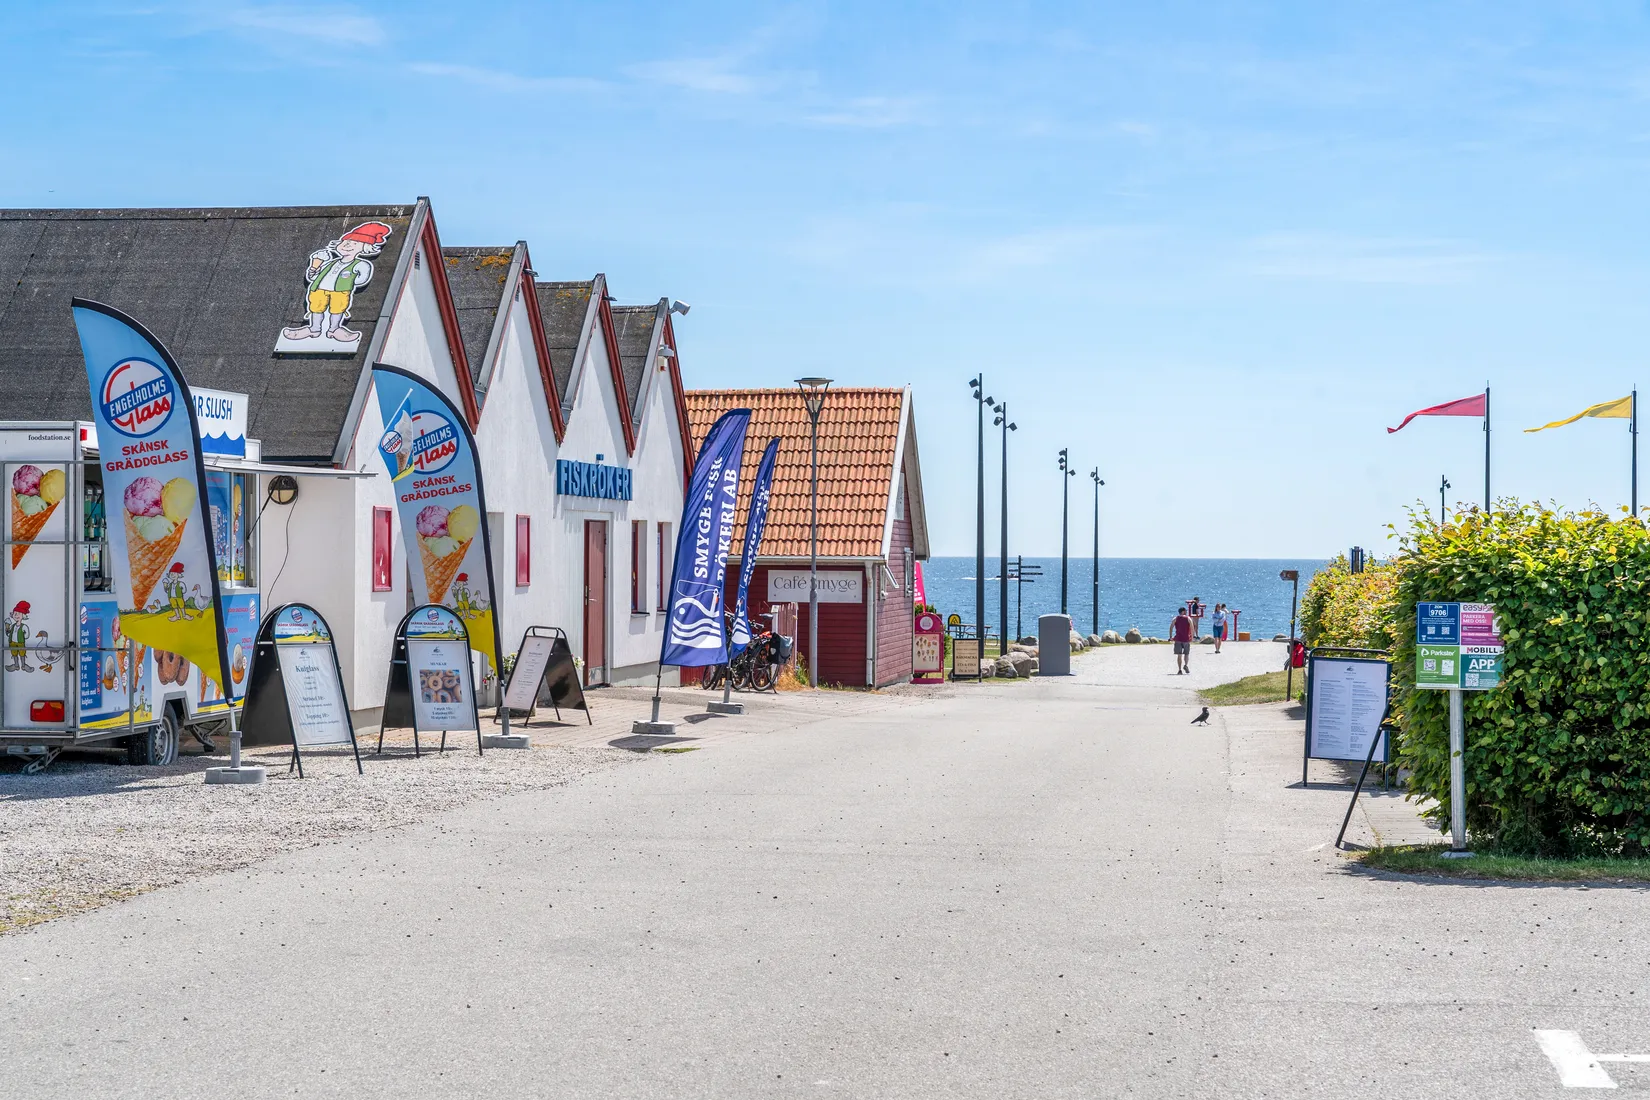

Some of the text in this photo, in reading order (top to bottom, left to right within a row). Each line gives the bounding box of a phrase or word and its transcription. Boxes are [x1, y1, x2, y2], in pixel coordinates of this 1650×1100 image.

[109, 379, 167, 418] ENGELHOLMS
[205, 397, 232, 420] SLUSH
[121, 440, 169, 456] SKÅNSK
[413, 427, 452, 453] GELHOLMS
[106, 450, 189, 472] GRÄDDGLASS
[412, 475, 456, 489] SKÅNSK
[557, 454, 633, 501] FISKRÖKERI
[723, 469, 737, 499] AB
[401, 483, 472, 503] GRÄDDGLASS
[694, 507, 712, 578] SMYGE
[773, 576, 857, 592] Café myge
[1469, 659, 1495, 669] APP
